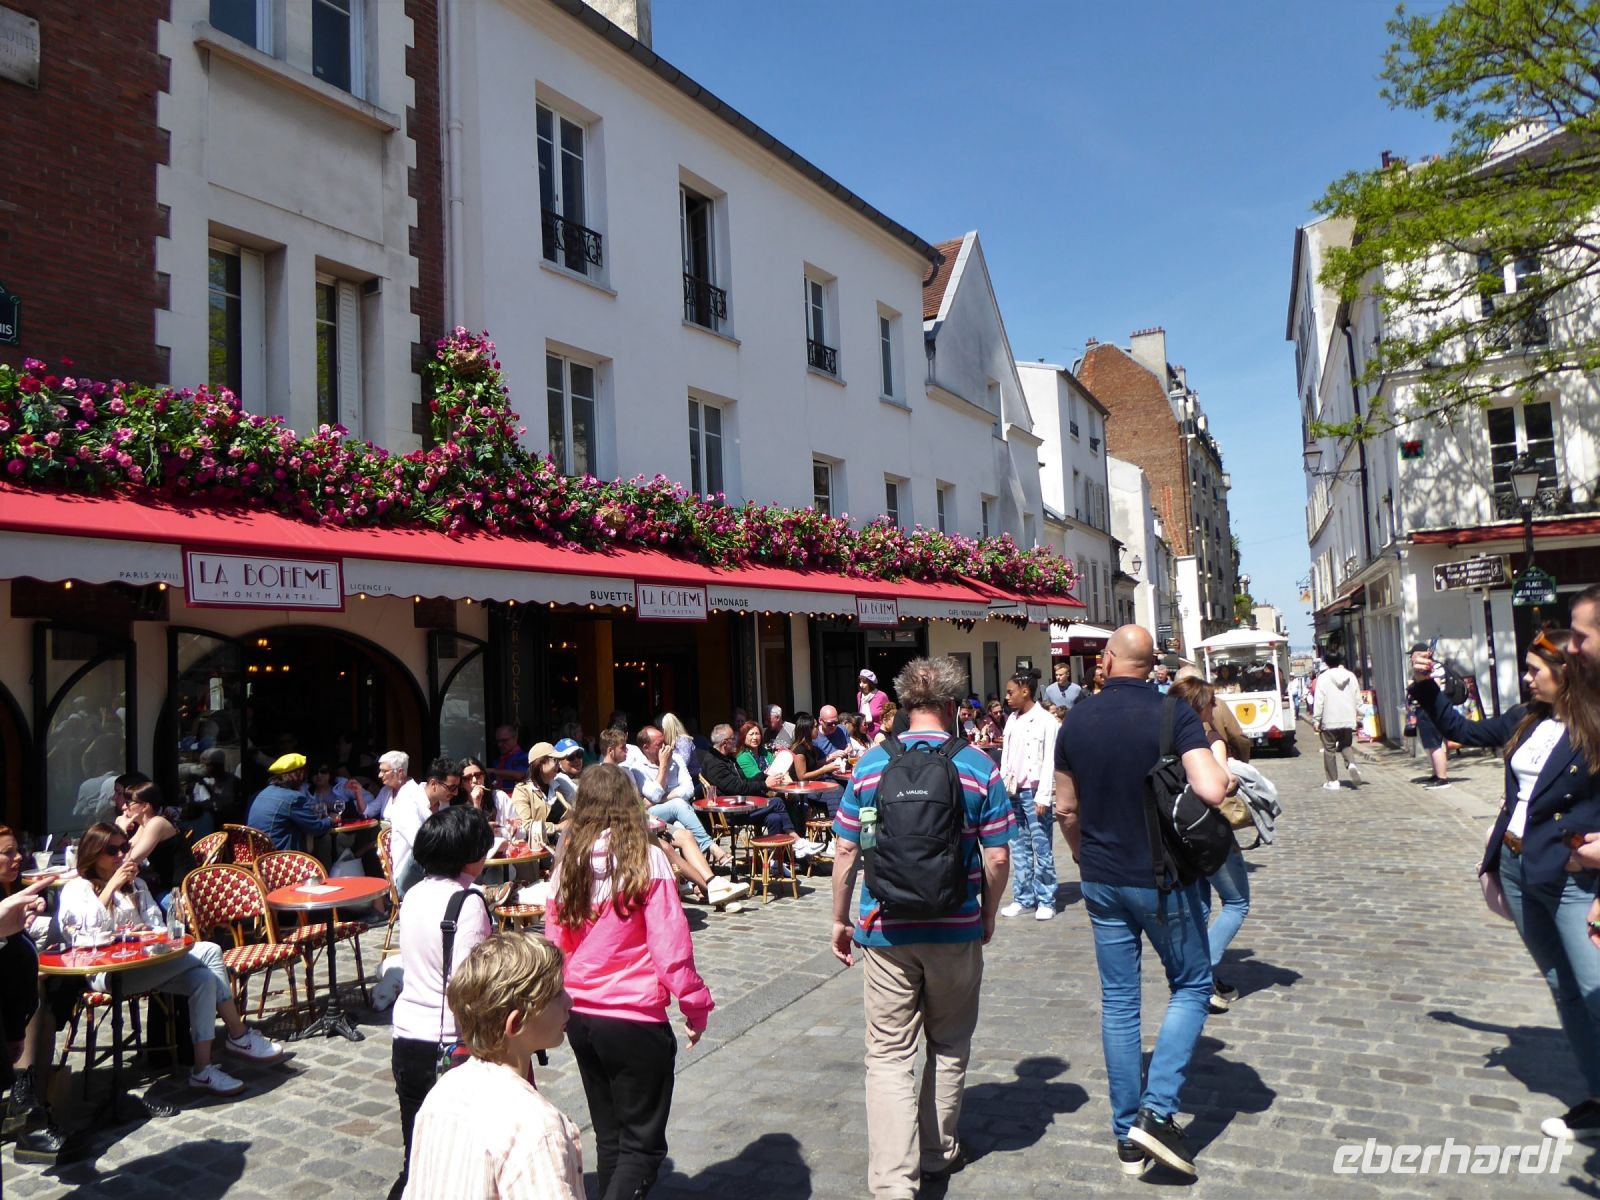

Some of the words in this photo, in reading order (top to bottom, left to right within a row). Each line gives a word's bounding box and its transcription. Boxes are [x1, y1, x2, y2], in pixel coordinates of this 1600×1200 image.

[119, 571, 150, 580] PARIS
[155, 572, 179, 580] XVIII
[199, 561, 229, 585] LA
[350, 583, 382, 591] LICENCE
[590, 590, 634, 602] BUVETTE
[642, 589, 656, 605] LA
[710, 597, 750, 608] LIMONADE
